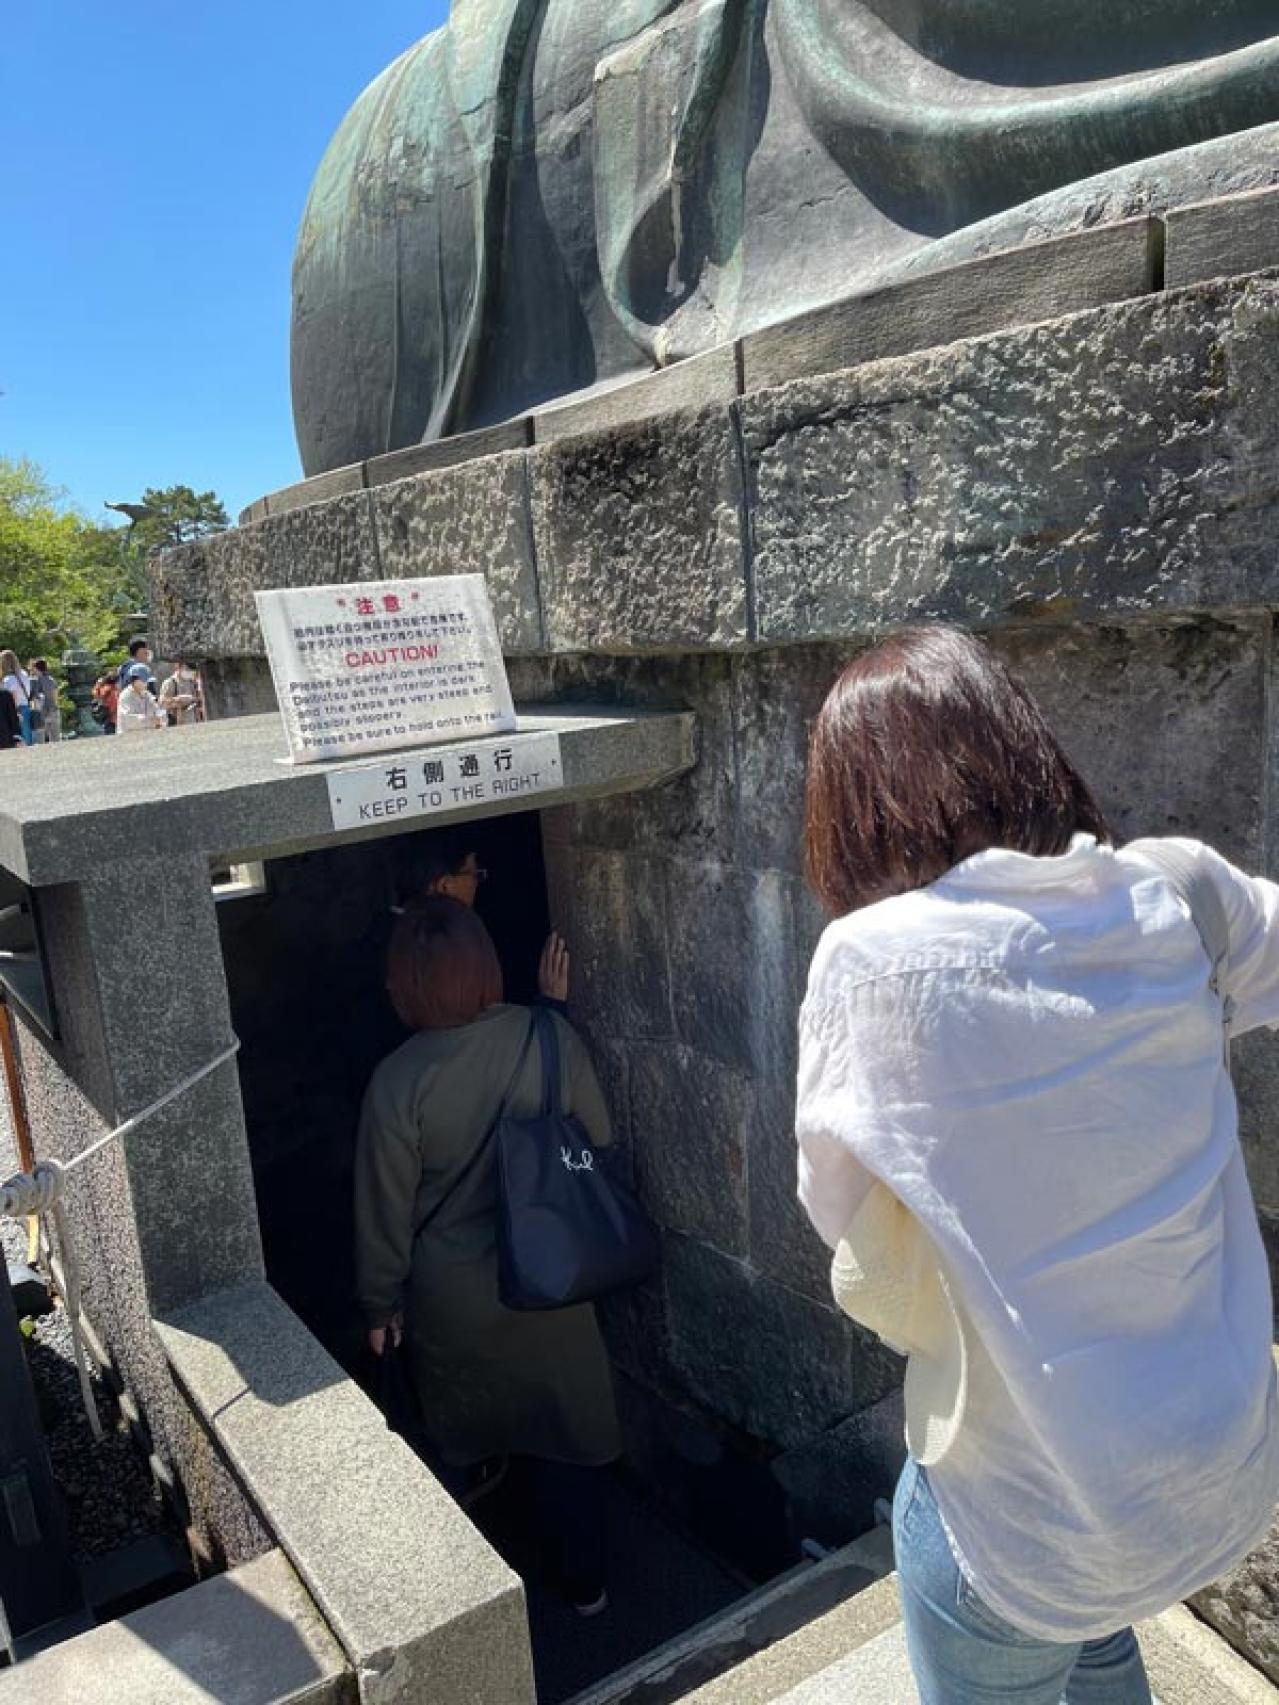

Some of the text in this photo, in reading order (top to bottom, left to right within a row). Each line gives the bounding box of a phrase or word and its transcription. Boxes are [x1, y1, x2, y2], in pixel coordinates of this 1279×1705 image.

[355, 594, 400, 614] 注意
[290, 660, 485, 694] Please be careful on entering the
[293, 691, 348, 706] Daibutsu
[352, 689, 366, 698] as
[369, 685, 388, 696] the
[298, 707, 320, 719] and
[325, 704, 346, 715] the
[350, 700, 385, 714] steps
[388, 697, 406, 706] are
[409, 693, 434, 705] very
[472, 684, 493, 695] and
[300, 719, 351, 731] possibly
[303, 735, 346, 747] Please
[347, 732, 363, 743] be
[367, 728, 391, 739] sure
[394, 725, 405, 734] to
[409, 721, 433, 732] hold
[437, 717, 462, 729] onto
[465, 715, 482, 724] the
[385, 748, 513, 791] 右側通行
[359, 796, 408, 819] KEEP
[418, 792, 443, 809] TO
[450, 782, 485, 802] THE
